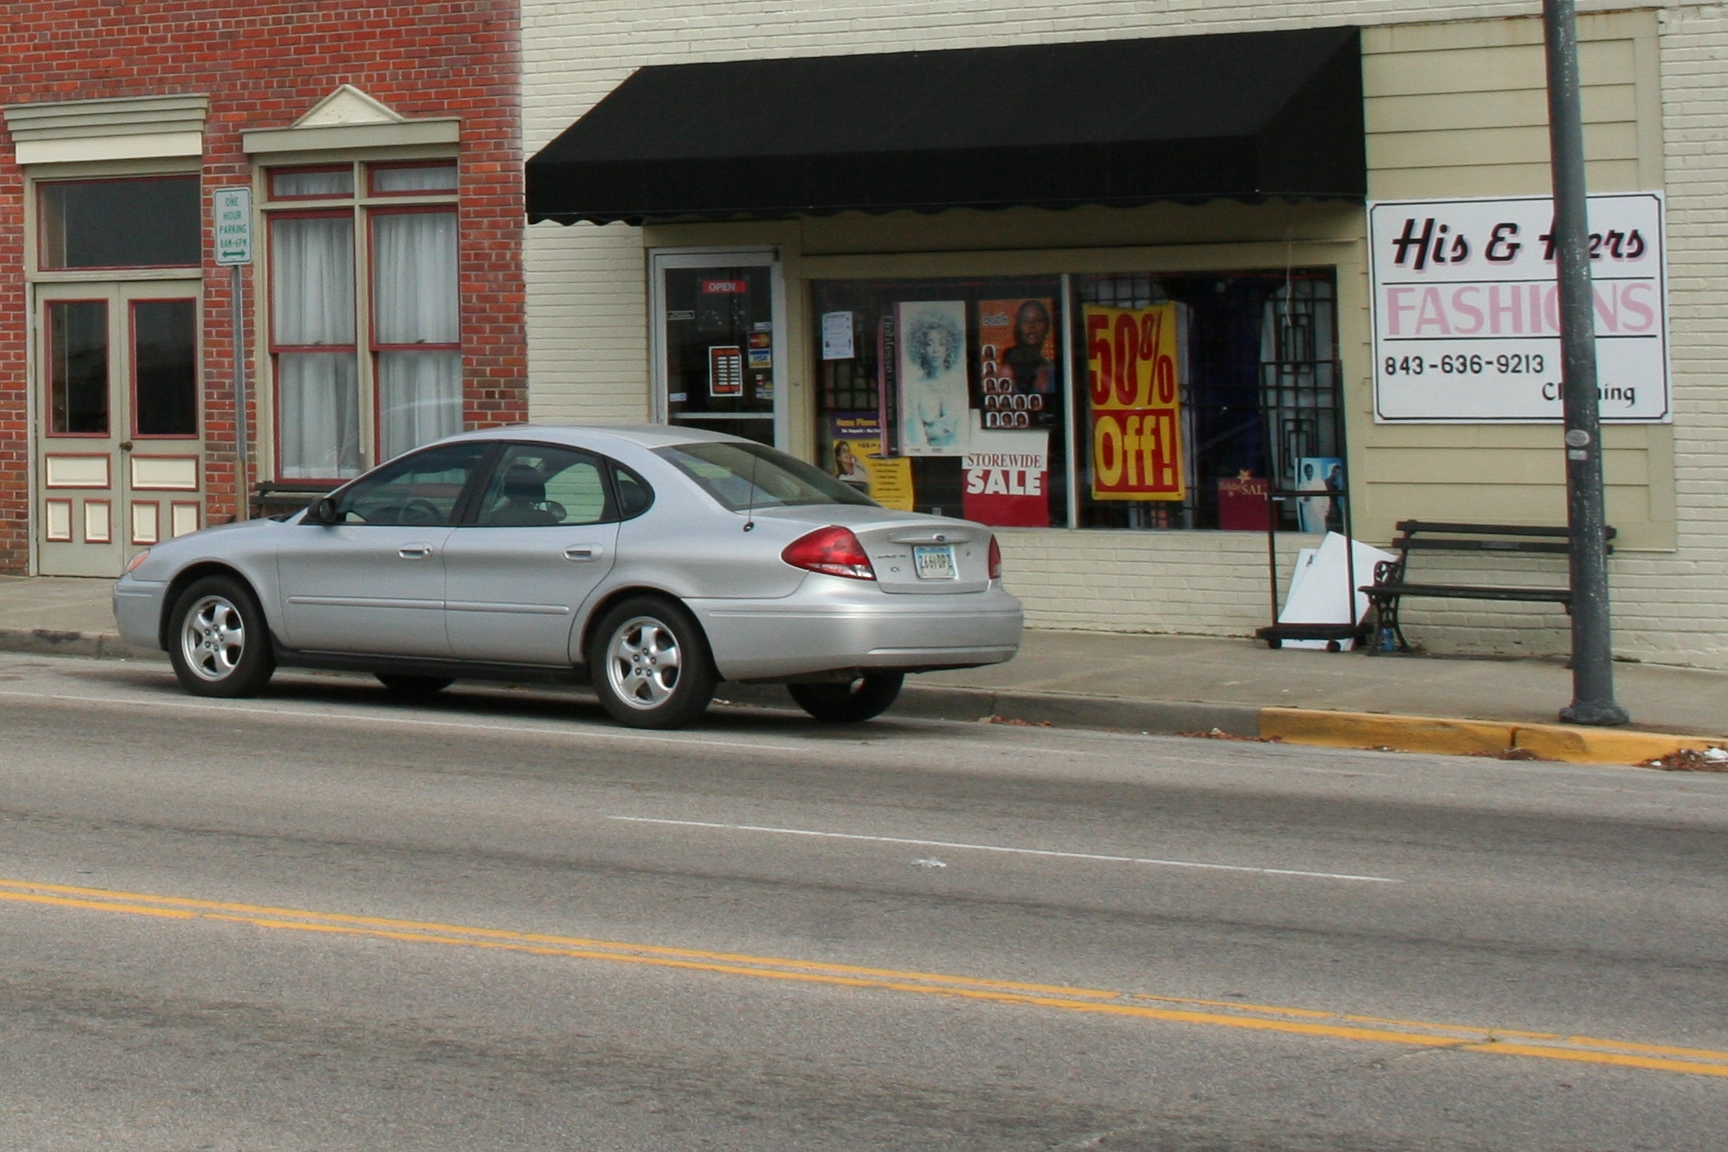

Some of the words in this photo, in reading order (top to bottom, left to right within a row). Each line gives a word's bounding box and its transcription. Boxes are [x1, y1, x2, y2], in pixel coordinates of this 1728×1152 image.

[225, 197, 239, 206] ONE
[219, 224, 247, 234] PARKING
[1392, 218, 1470, 271] His
[1484, 223, 1521, 263] &
[709, 282, 736, 291] OPEN
[1087, 310, 1175, 405] 50%
[1384, 354, 1545, 375] 843-636-9213
[967, 453, 1042, 468] STOREWIDE
[1094, 415, 1173, 487] Off!
[966, 469, 1041, 496] SALE
